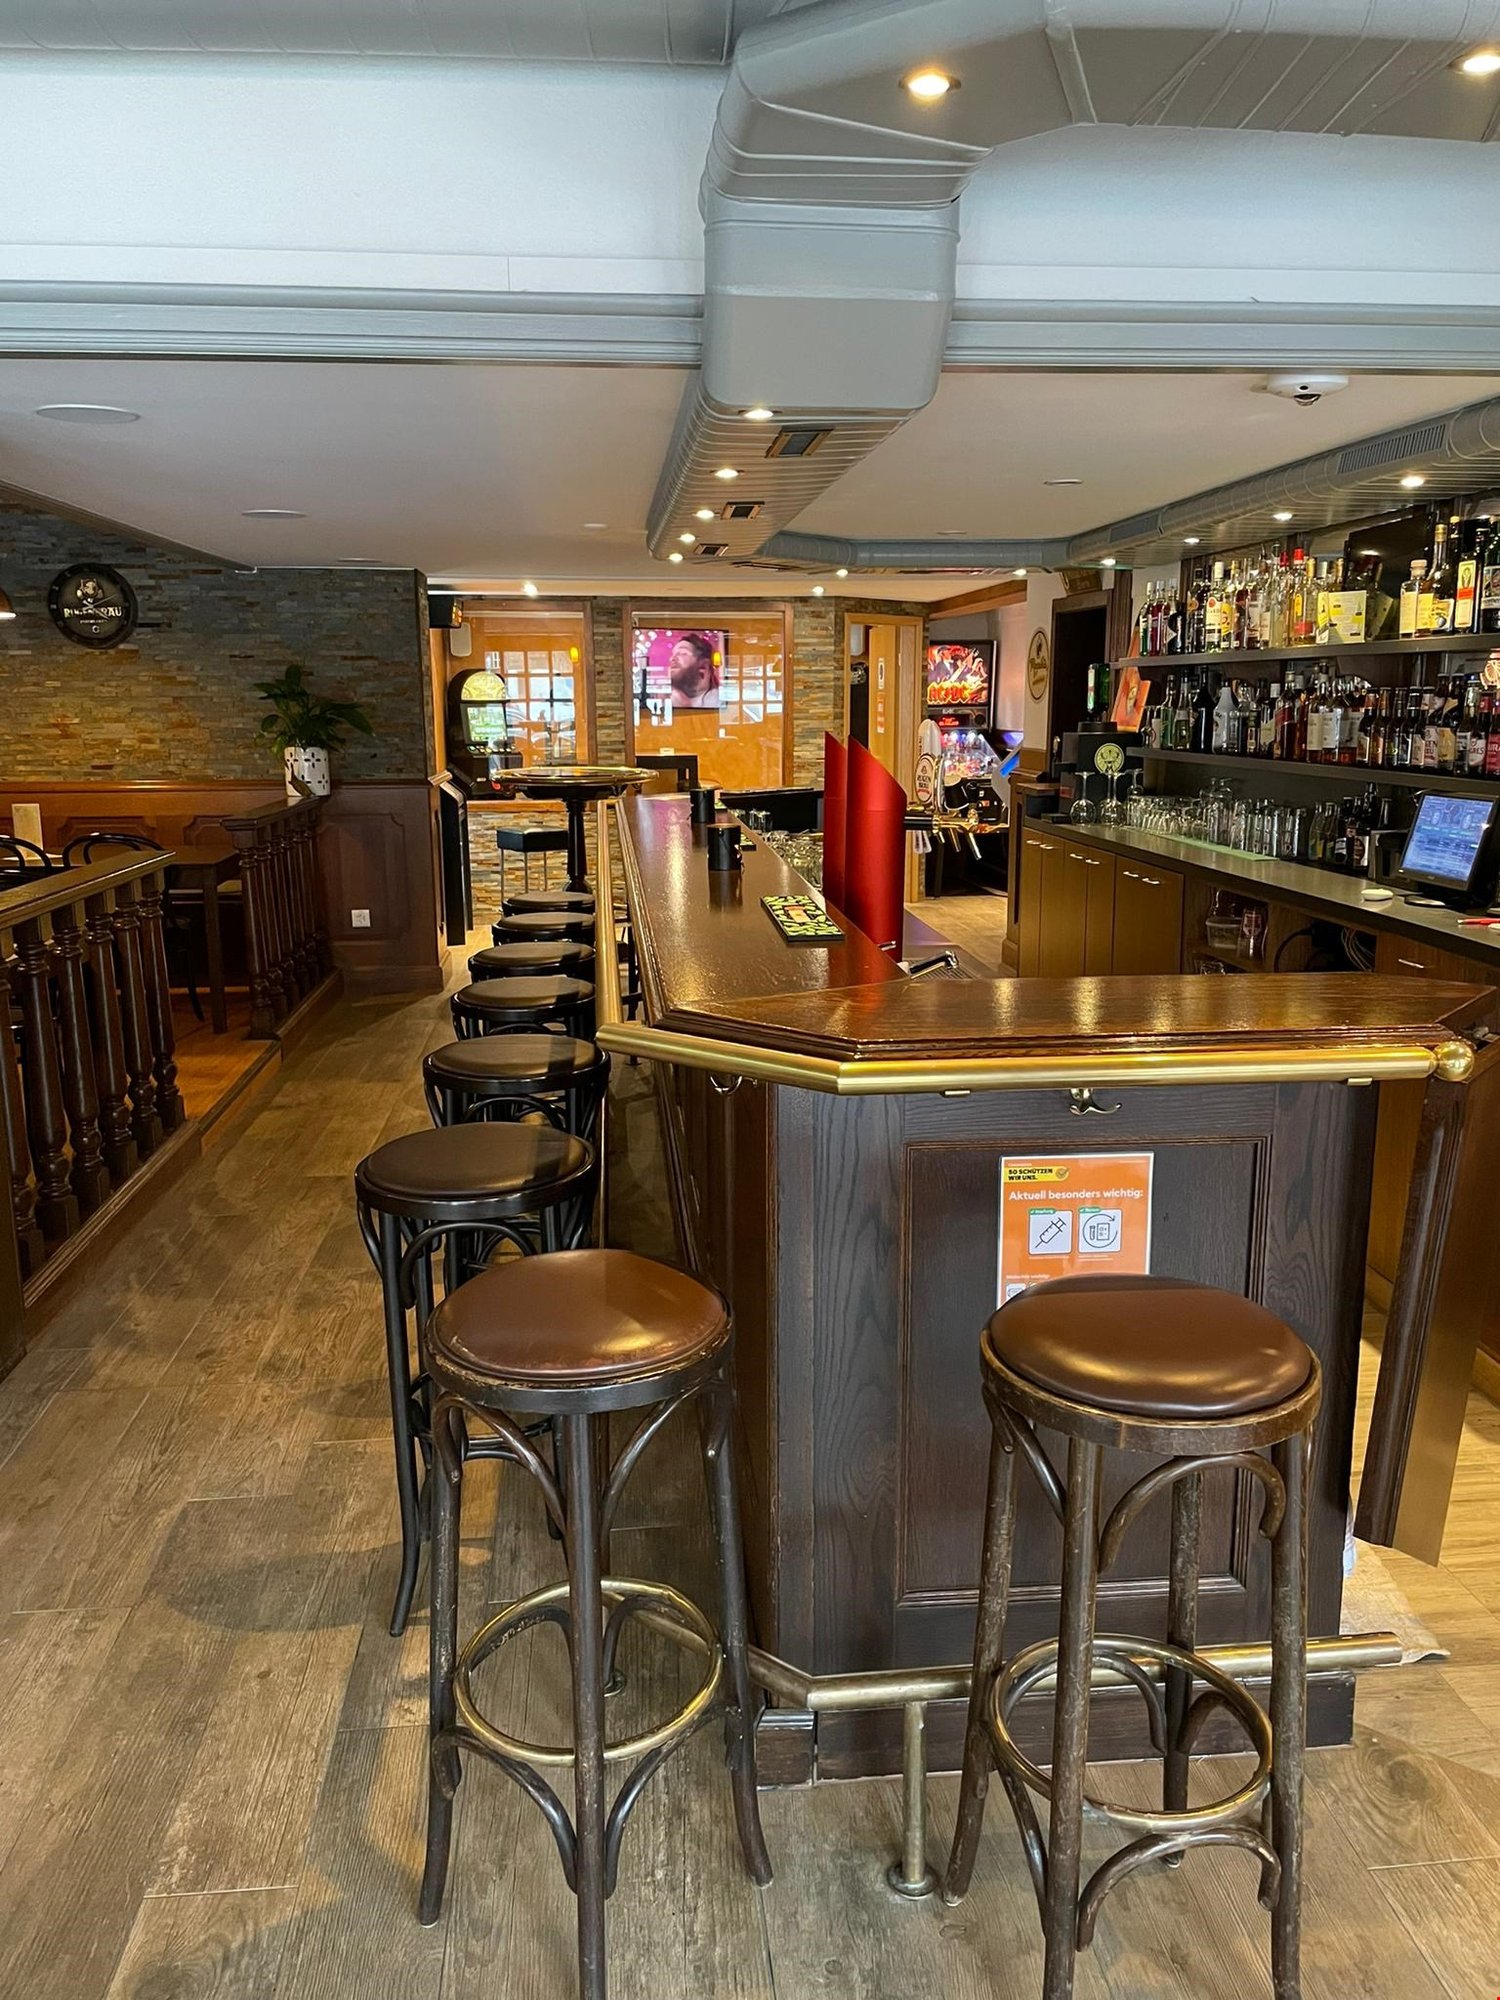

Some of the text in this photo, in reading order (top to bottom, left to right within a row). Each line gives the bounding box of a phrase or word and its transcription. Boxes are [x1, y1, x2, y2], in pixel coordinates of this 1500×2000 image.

[1009, 1187, 1144, 1200] Aktuell besonders wichtig:
